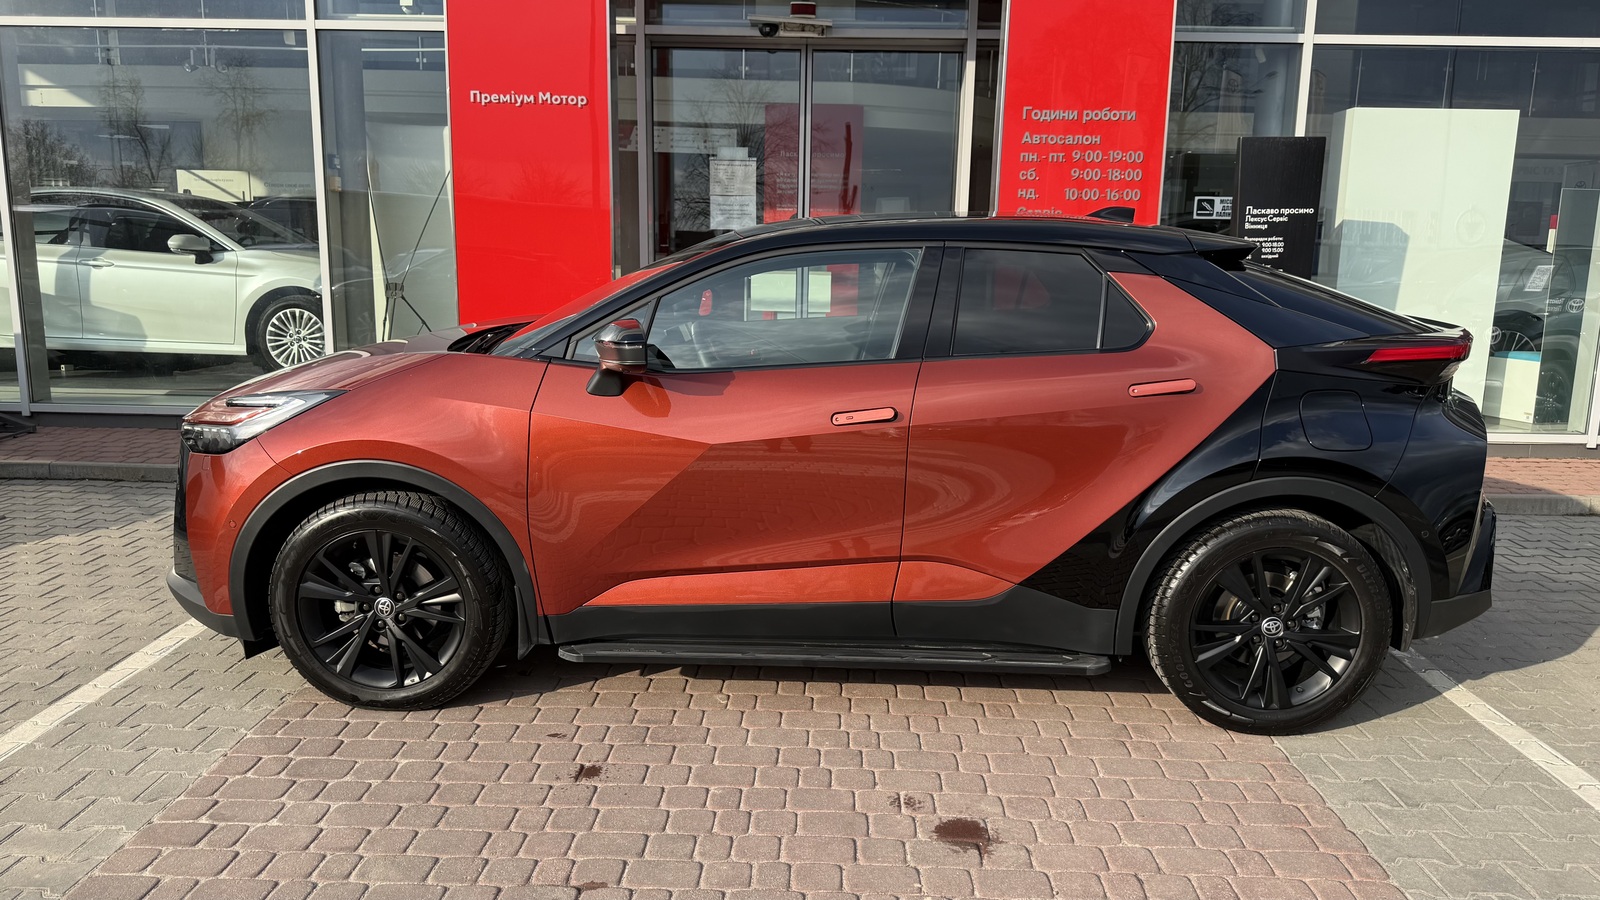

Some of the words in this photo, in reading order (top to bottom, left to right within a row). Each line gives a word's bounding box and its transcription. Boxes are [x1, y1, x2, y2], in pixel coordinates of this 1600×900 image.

[469, 90, 535, 107] Преміум
[538, 91, 588, 108] Мотор
[1022, 106, 1078, 122] Години
[1082, 107, 1136, 123] роботи
[1021, 131, 1101, 145] Автосалон
[1071, 150, 1144, 163] 9:00-19:00
[1019, 168, 1040, 180] сб.
[1071, 168, 1143, 181] 9:00-18:00
[1017, 188, 1040, 200] нд.
[1064, 188, 1141, 201] 10:00-16:00
[1245, 205, 1279, 215] Ласкаво
[1280, 207, 1315, 216] просимо
[1245, 215, 1267, 223] Лексус
[1267, 214, 1288, 222] Сервіс
